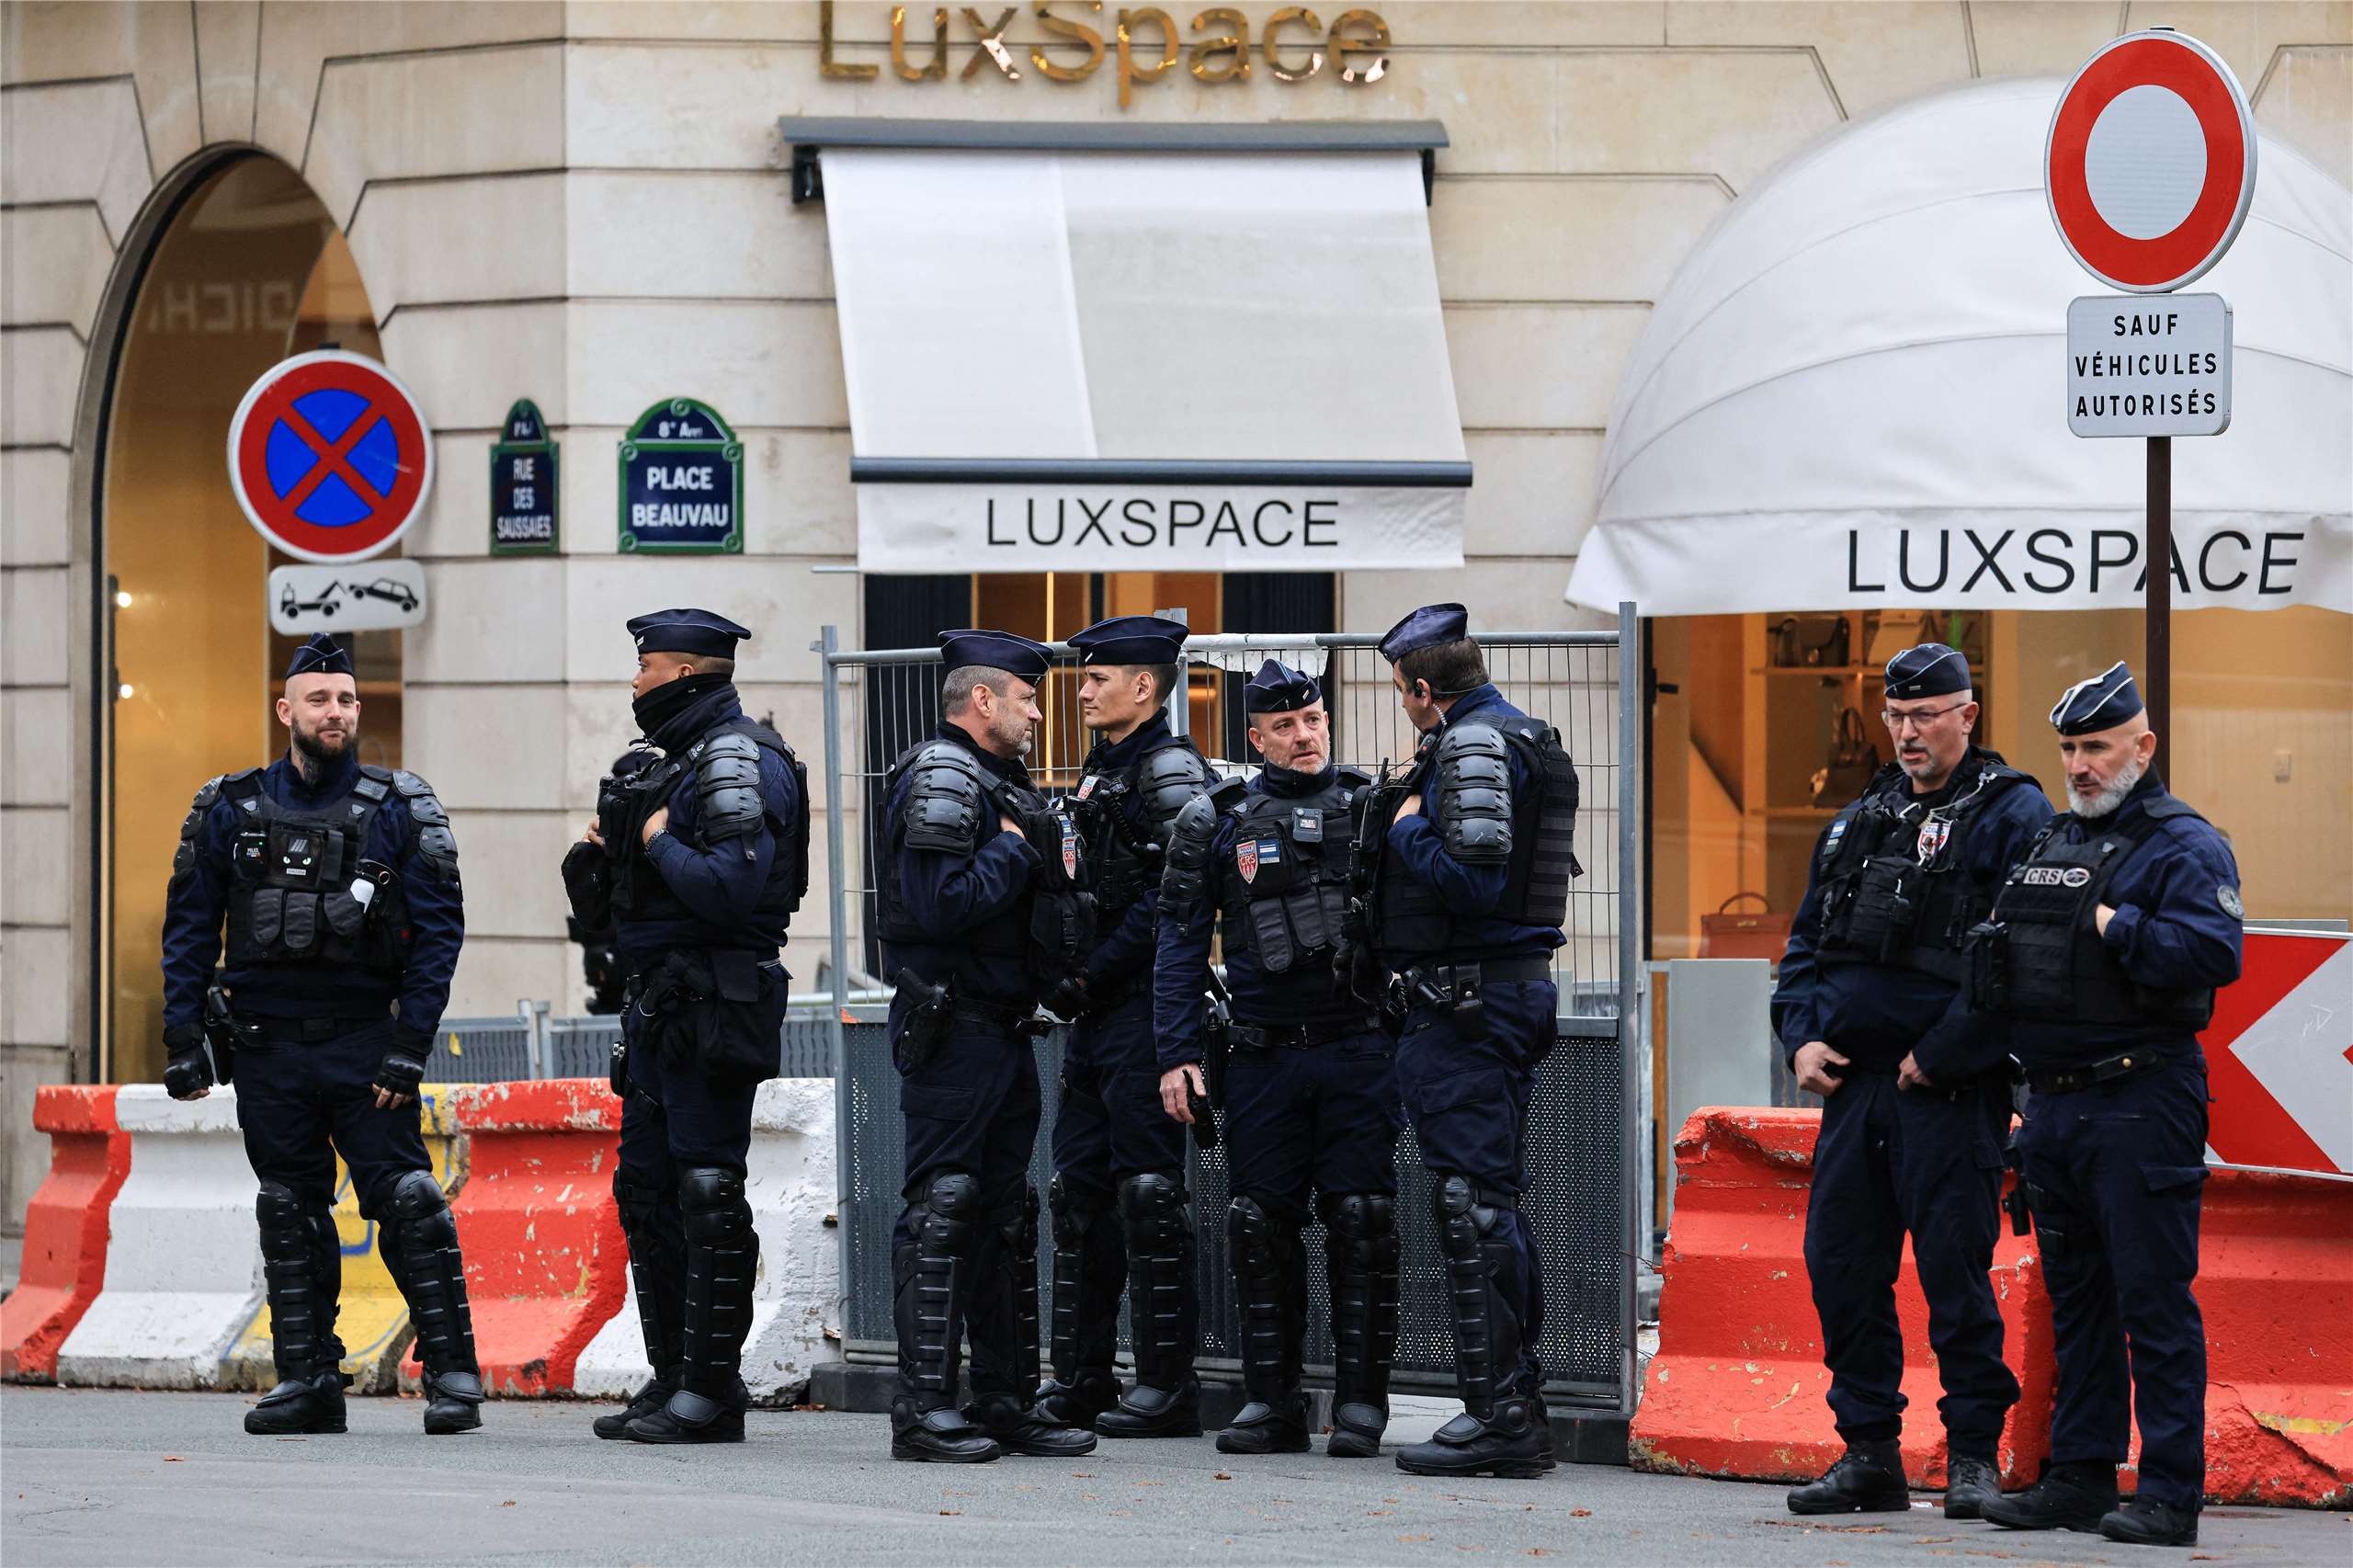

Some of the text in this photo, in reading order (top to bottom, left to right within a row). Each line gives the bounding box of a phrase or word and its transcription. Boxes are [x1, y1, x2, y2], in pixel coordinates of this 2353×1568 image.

[820, 0, 1392, 108] LuxSpace
[2113, 313, 2178, 337] SAUF
[2075, 350, 2217, 377] VÉHICULES
[2075, 388, 2217, 417] AUTORISÉS
[513, 459, 535, 481] RUE
[646, 466, 713, 490] PLACE
[513, 488, 535, 509] DES
[496, 516, 552, 540] SAUSSAIES
[631, 504, 729, 528] BEAUVAU
[988, 498, 1340, 548] LUXSPACE
[1848, 528, 2305, 596] LUXSPACE
[1240, 854, 1256, 866] CRS
[2028, 869, 2060, 883] CRS
